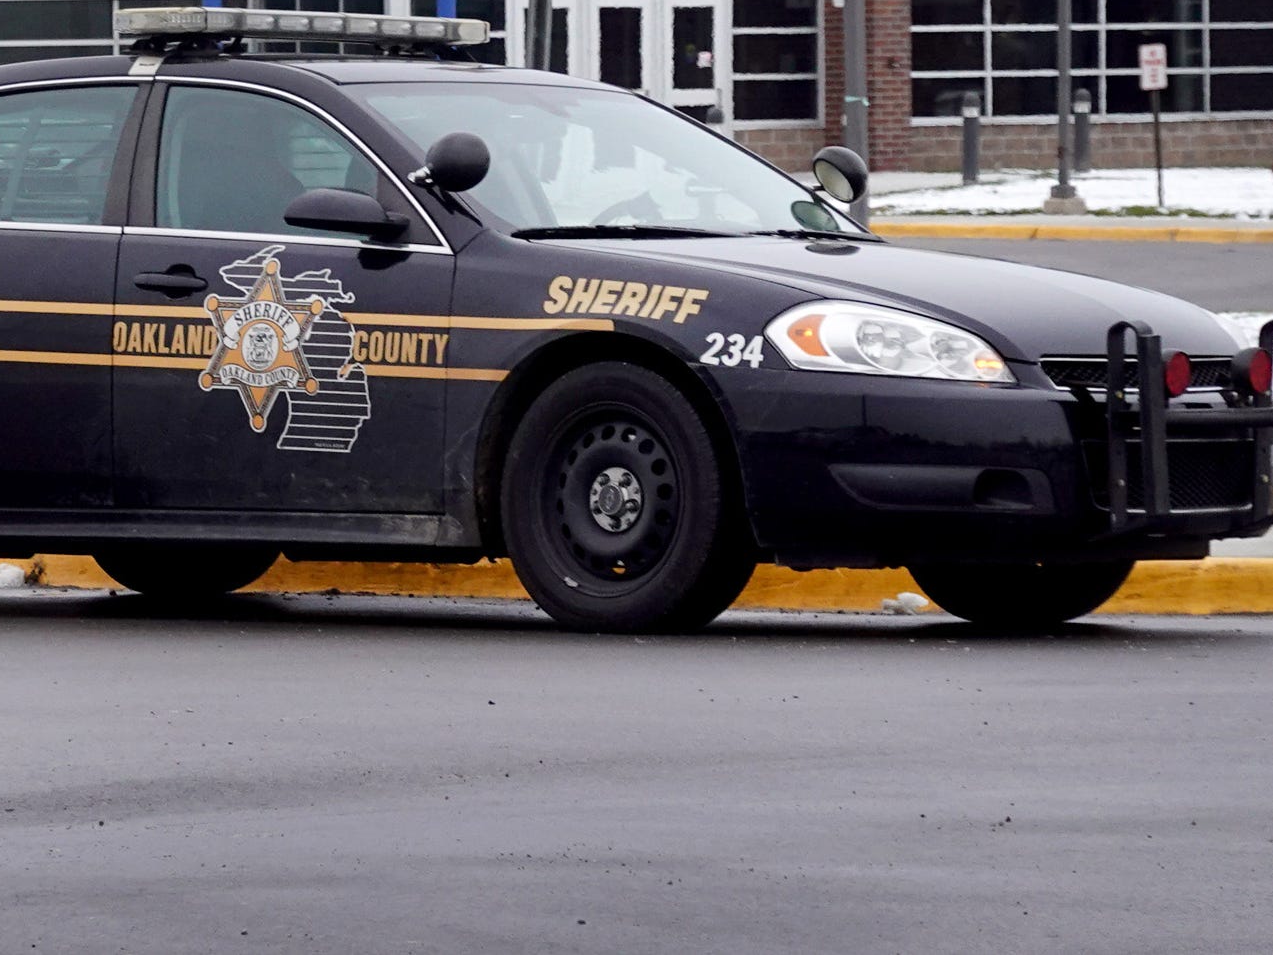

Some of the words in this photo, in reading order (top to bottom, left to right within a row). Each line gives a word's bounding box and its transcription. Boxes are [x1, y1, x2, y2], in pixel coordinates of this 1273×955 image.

[234, 302, 294, 330] SHERIFF
[543, 275, 709, 324] SHERIFF
[112, 321, 218, 356] OAKLAND
[353, 330, 449, 365] COUNTY
[699, 332, 764, 369] 234
[222, 366, 263, 385] OAKLAND
[263, 368, 297, 385] COUNTY
